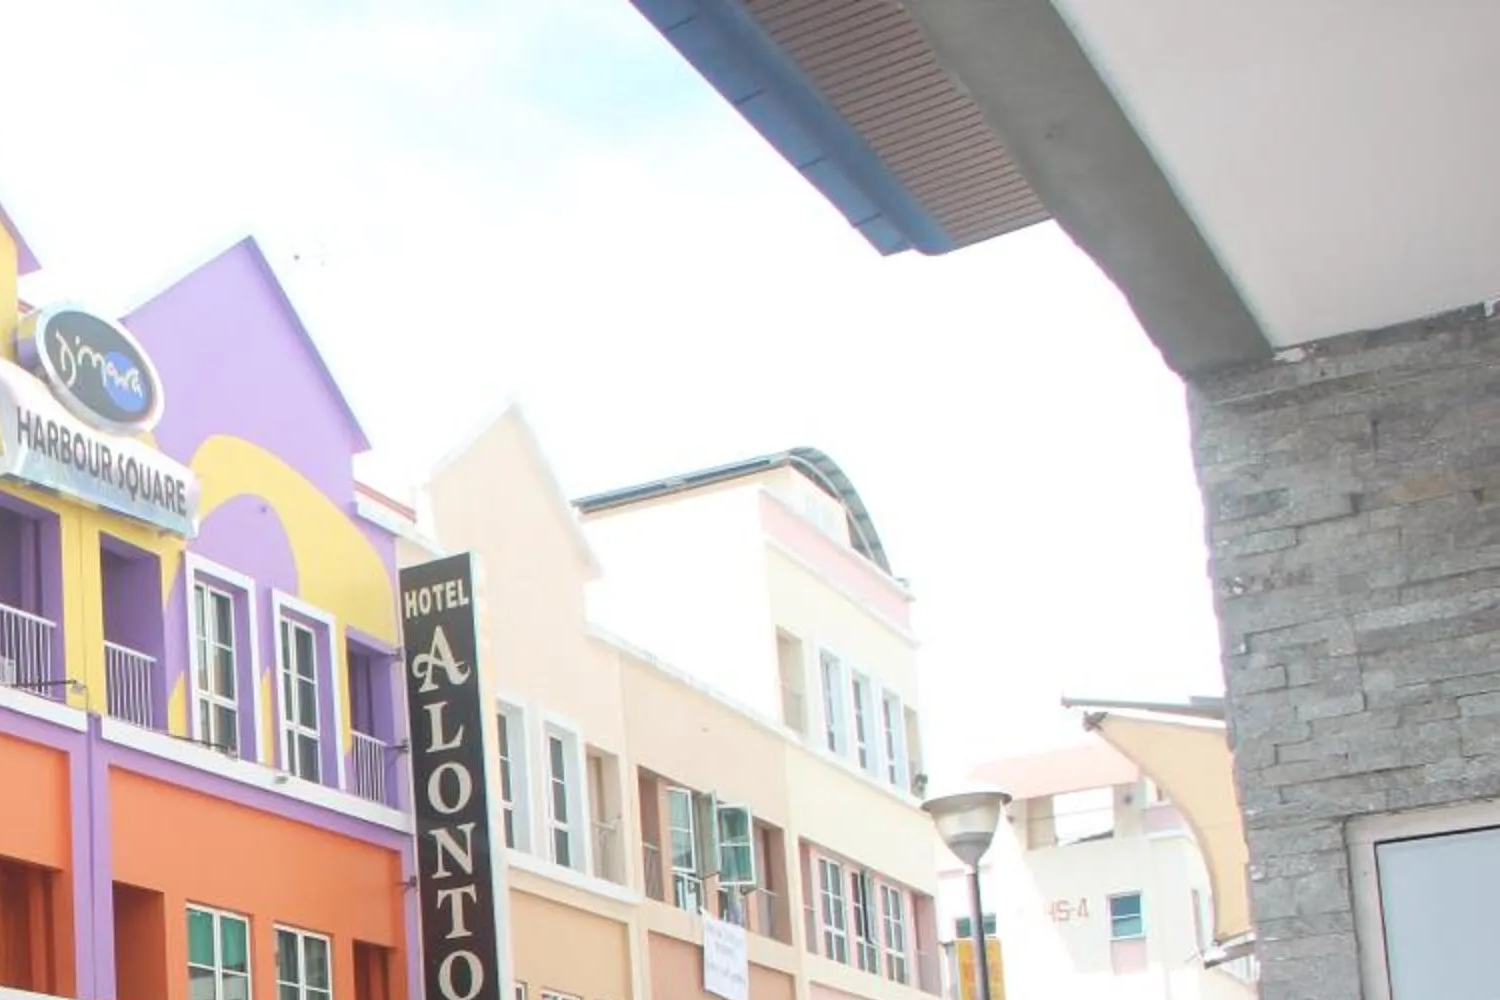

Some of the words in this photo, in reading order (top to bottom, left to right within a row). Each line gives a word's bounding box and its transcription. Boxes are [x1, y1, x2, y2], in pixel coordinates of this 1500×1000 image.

[16, 405, 113, 486] HARBOUR
[116, 453, 187, 516] SQUARE
[404, 577, 470, 620] HOTEL
